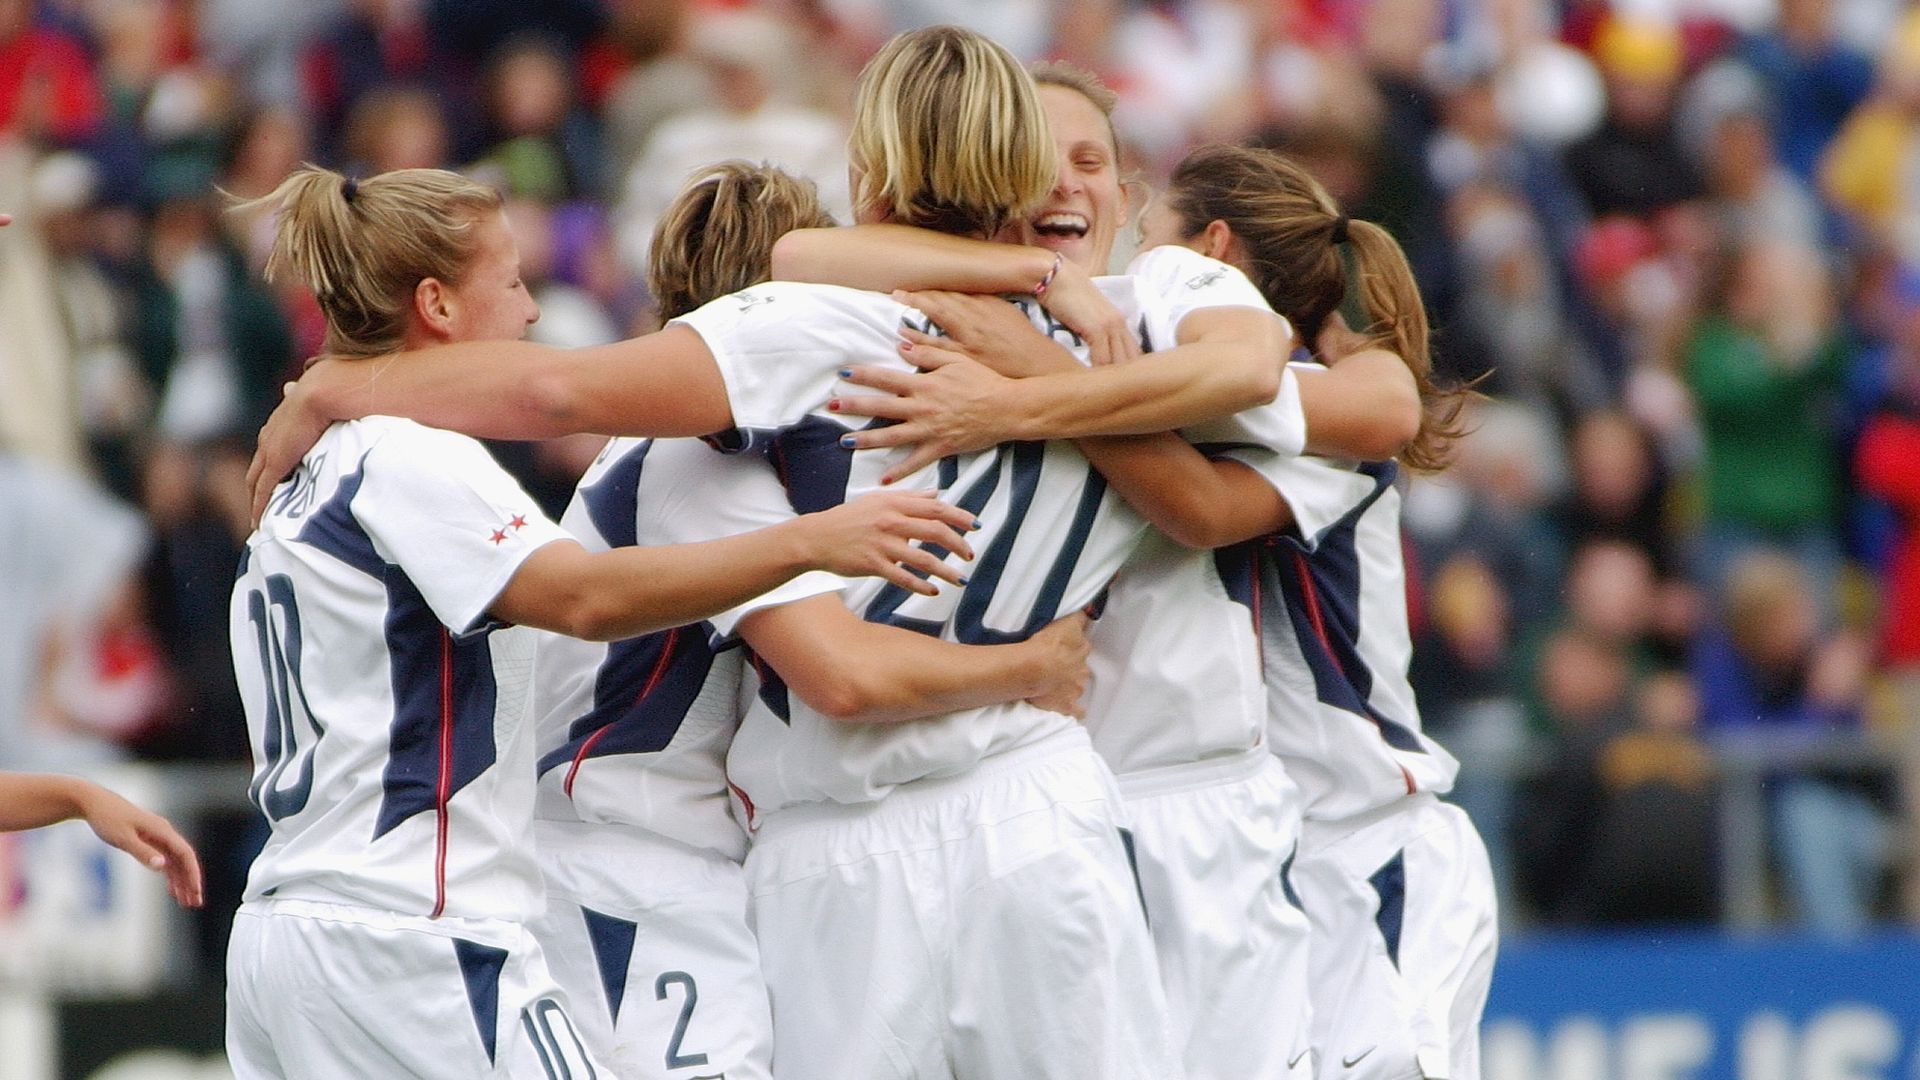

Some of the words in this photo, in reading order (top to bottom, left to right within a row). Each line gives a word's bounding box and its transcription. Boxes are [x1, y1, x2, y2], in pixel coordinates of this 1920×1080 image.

[864, 440, 1108, 645] 20
[247, 572, 328, 823] 10
[520, 998, 598, 1080] 10
[654, 970, 709, 1071] 2
